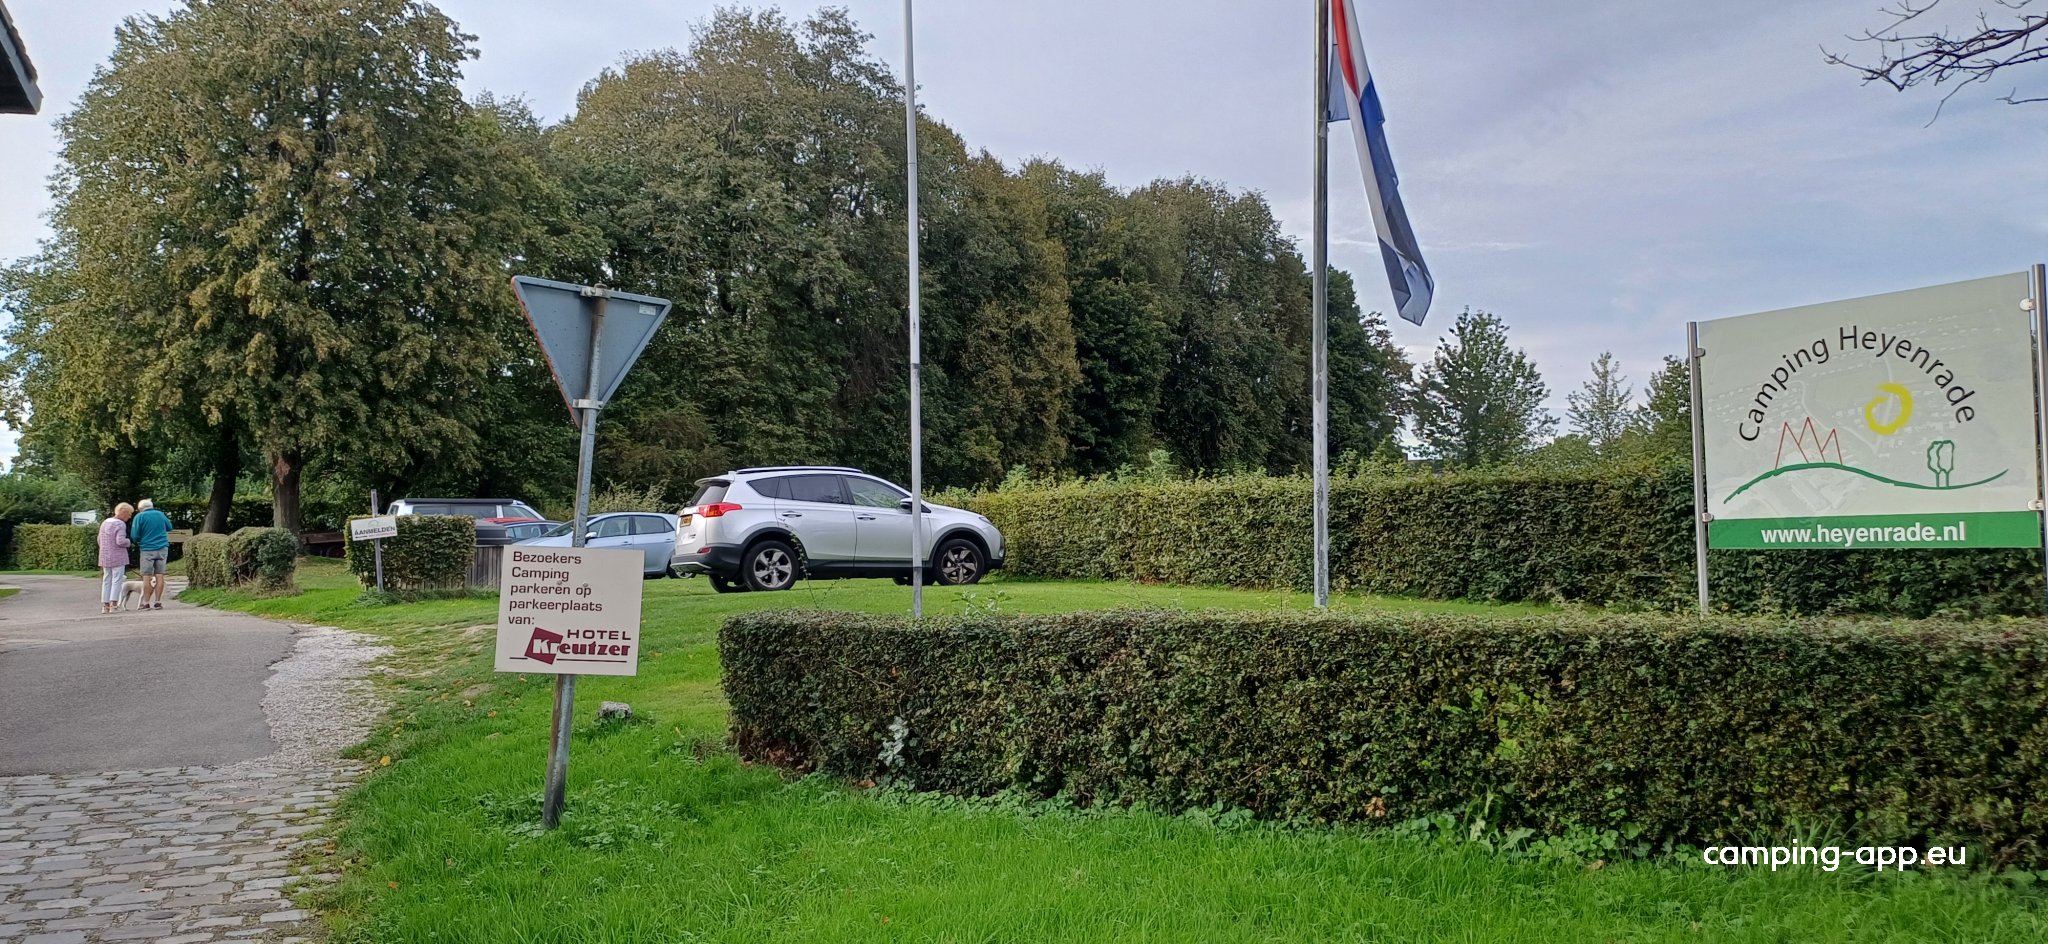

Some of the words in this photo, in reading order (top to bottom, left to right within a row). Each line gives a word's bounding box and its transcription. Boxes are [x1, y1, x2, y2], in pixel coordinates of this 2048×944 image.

[1739, 338, 1830, 442] Camping
[1839, 325, 1976, 424] Heyenrade
[355, 526, 396, 535] AANMELDEN
[1760, 520, 1966, 546] www.heyenrade.nl
[513, 551, 582, 564] Bezoekers
[512, 567, 570, 582] Camping
[510, 583, 571, 596] parkeren
[575, 586, 592, 598] op
[509, 599, 603, 613] parkeerplaats
[508, 616, 535, 625] van:
[567, 629, 631, 640] HOTEL
[532, 638, 631, 656] Kreutzer
